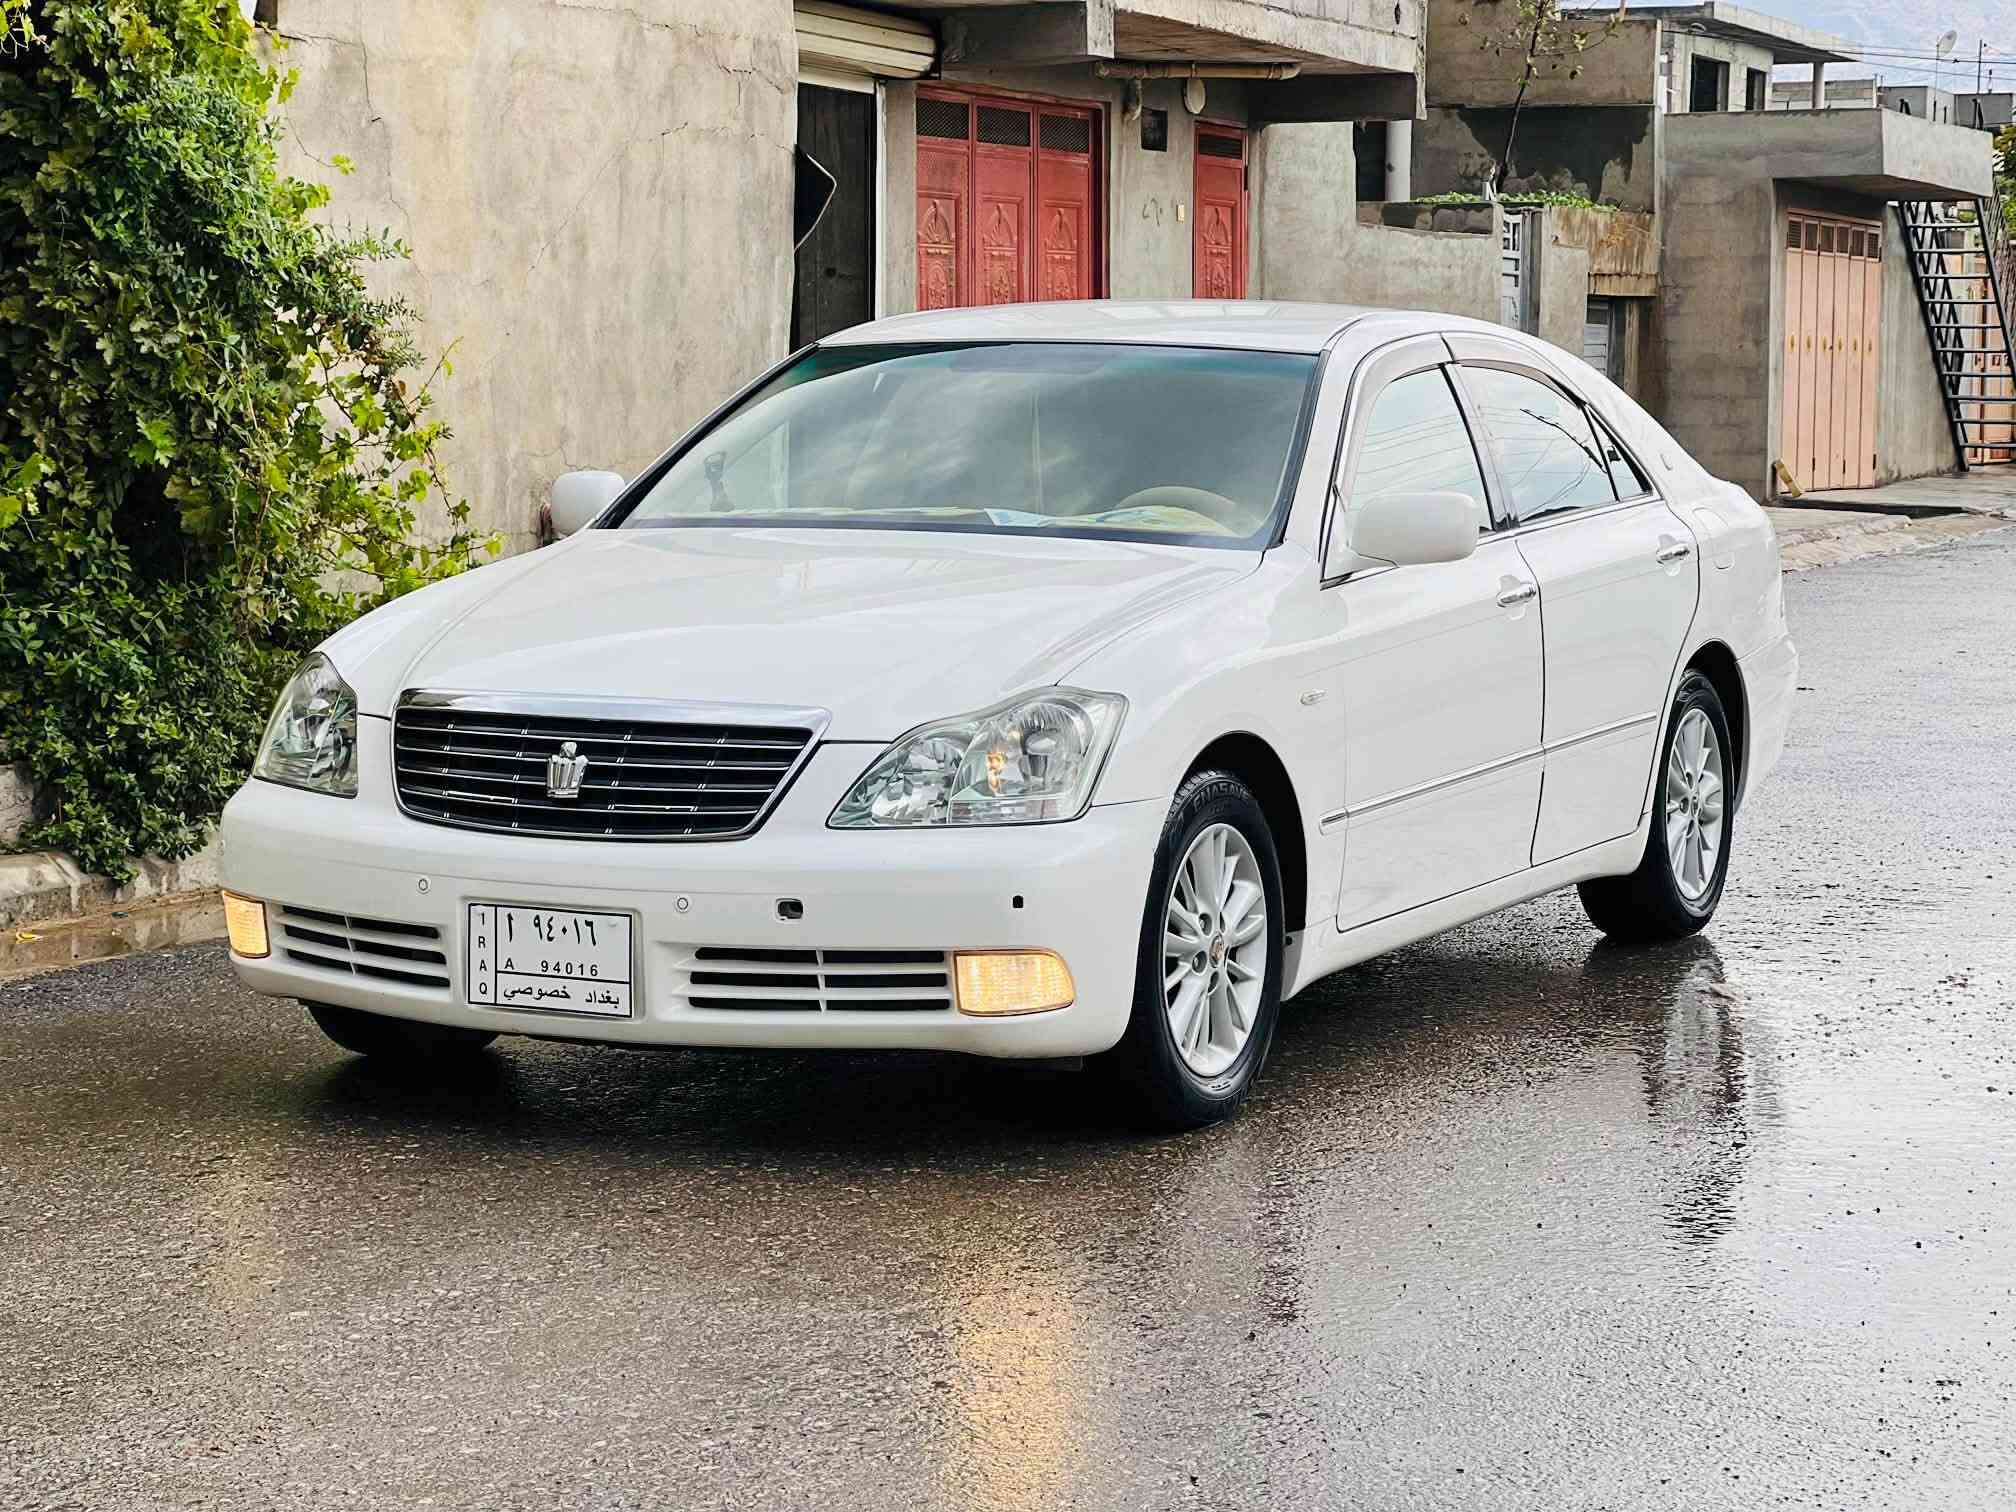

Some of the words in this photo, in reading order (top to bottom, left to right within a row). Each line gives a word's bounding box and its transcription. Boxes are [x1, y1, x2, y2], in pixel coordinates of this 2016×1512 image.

[533, 914, 597, 946] ٩٤٠١٦
[504, 957, 514, 970] A
[540, 960, 598, 976] 94016
[503, 985, 571, 1001] خصوصي
[585, 990, 620, 1009] بغداد
